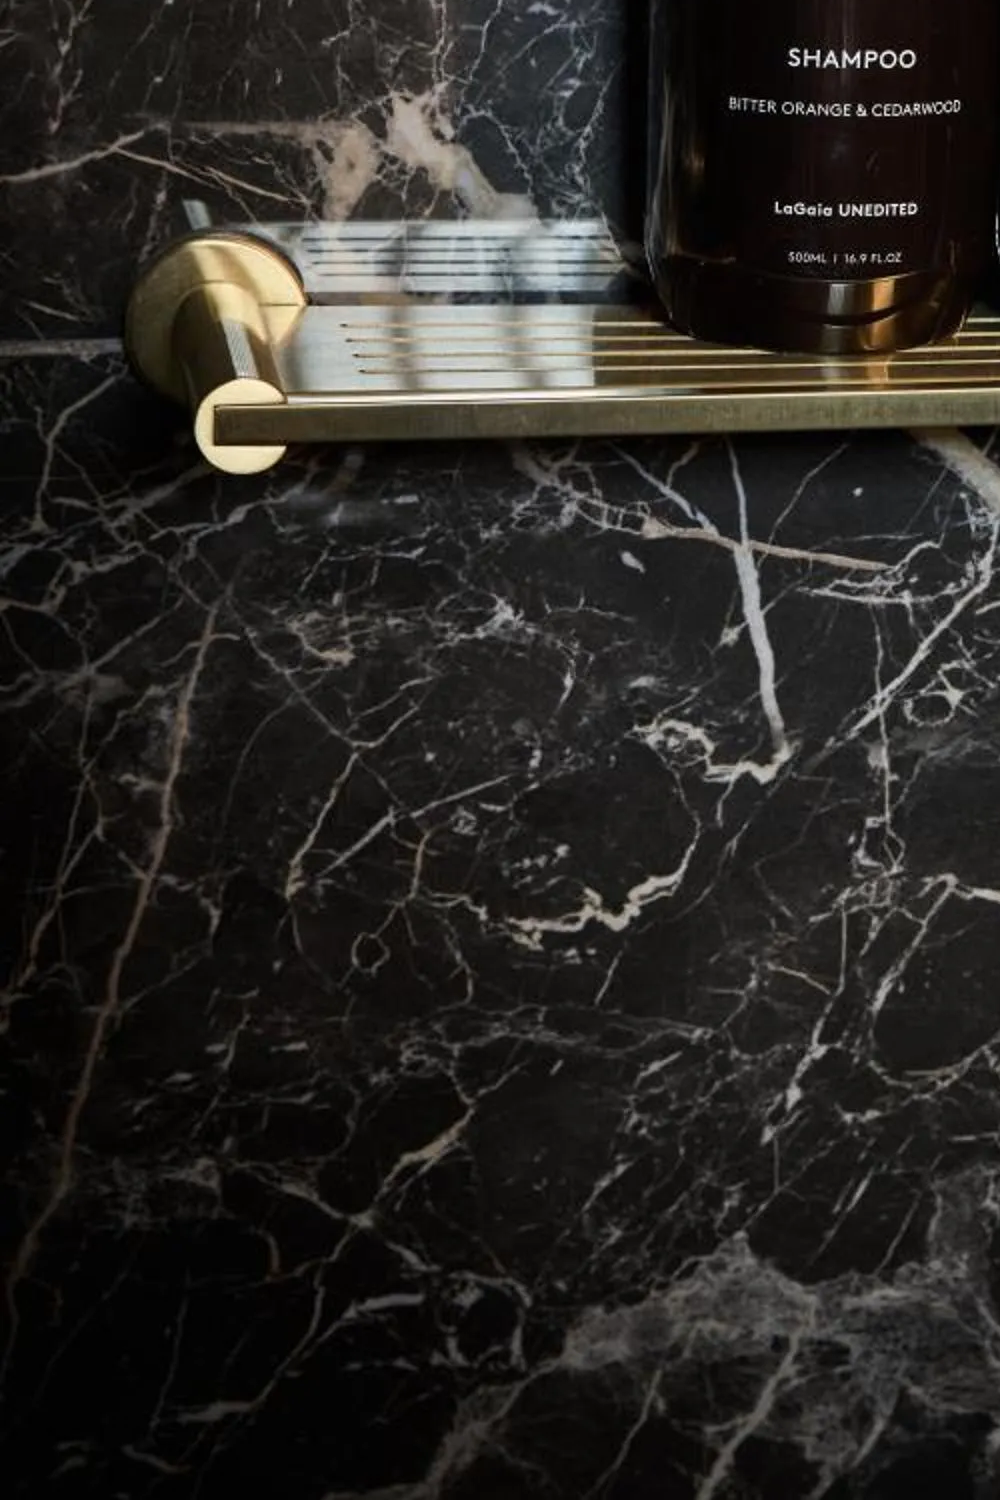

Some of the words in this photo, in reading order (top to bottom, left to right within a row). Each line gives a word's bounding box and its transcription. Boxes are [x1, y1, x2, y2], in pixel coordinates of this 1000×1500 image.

[787, 47, 917, 69] SHAMPOO
[728, 96, 777, 115] BITTER
[781, 101, 852, 117] ORANGE
[856, 102, 868, 117] &
[871, 99, 961, 117] CEDARWOOD
[774, 201, 833, 217] LaGaia
[838, 202, 918, 217] UNEDITED
[788, 251, 827, 263] 500ML
